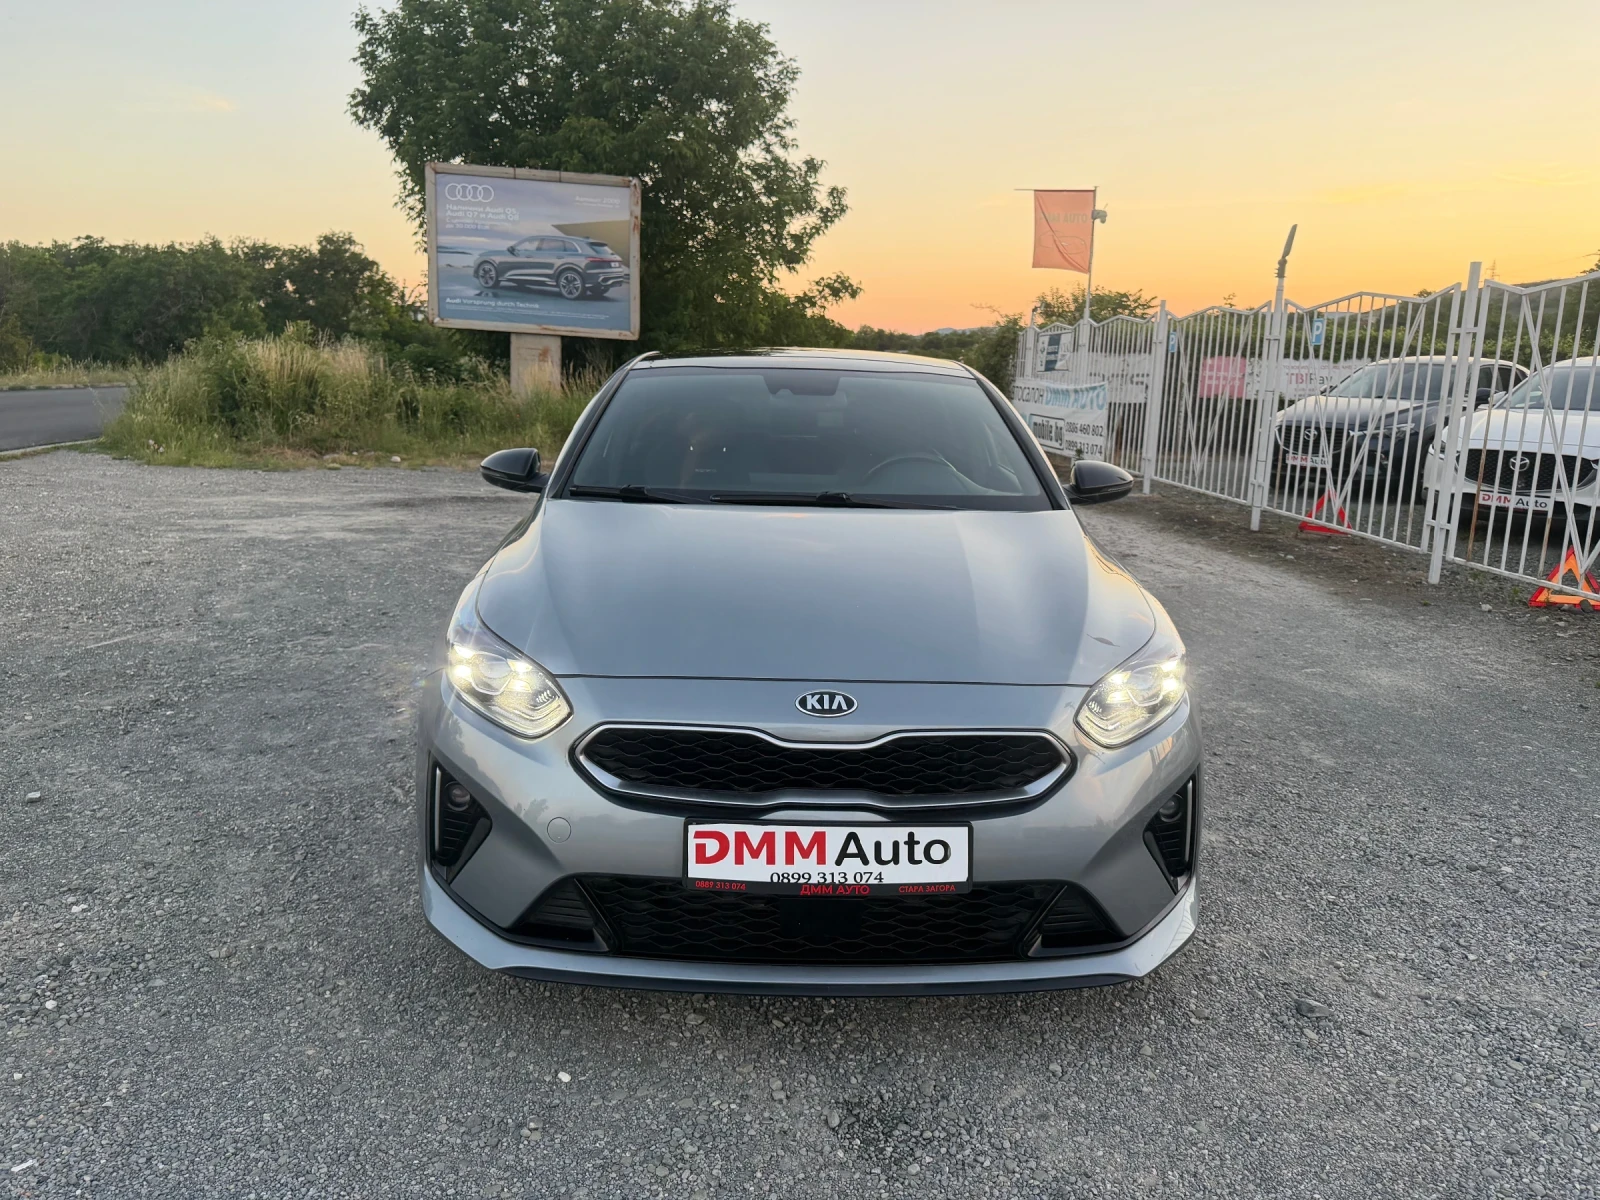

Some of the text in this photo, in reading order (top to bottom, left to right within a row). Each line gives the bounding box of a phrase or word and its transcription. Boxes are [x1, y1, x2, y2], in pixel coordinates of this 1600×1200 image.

[1063, 212, 1088, 224] AUTO
[463, 298, 495, 307] Vorsprung
[1071, 384, 1107, 411] AUTO
[1079, 422, 1091, 436] 460
[1091, 424, 1104, 437] 802
[1090, 443, 1103, 457] 074
[806, 694, 848, 710] KIA
[693, 830, 952, 867] DMM Auto
[769, 871, 884, 884] 0899 313 074
[715, 881, 730, 890] 313
[730, 882, 746, 891] 074
[800, 884, 871, 896] ДММ АУТО
[898, 884, 956, 893] СТАРА ЗАГОРА
